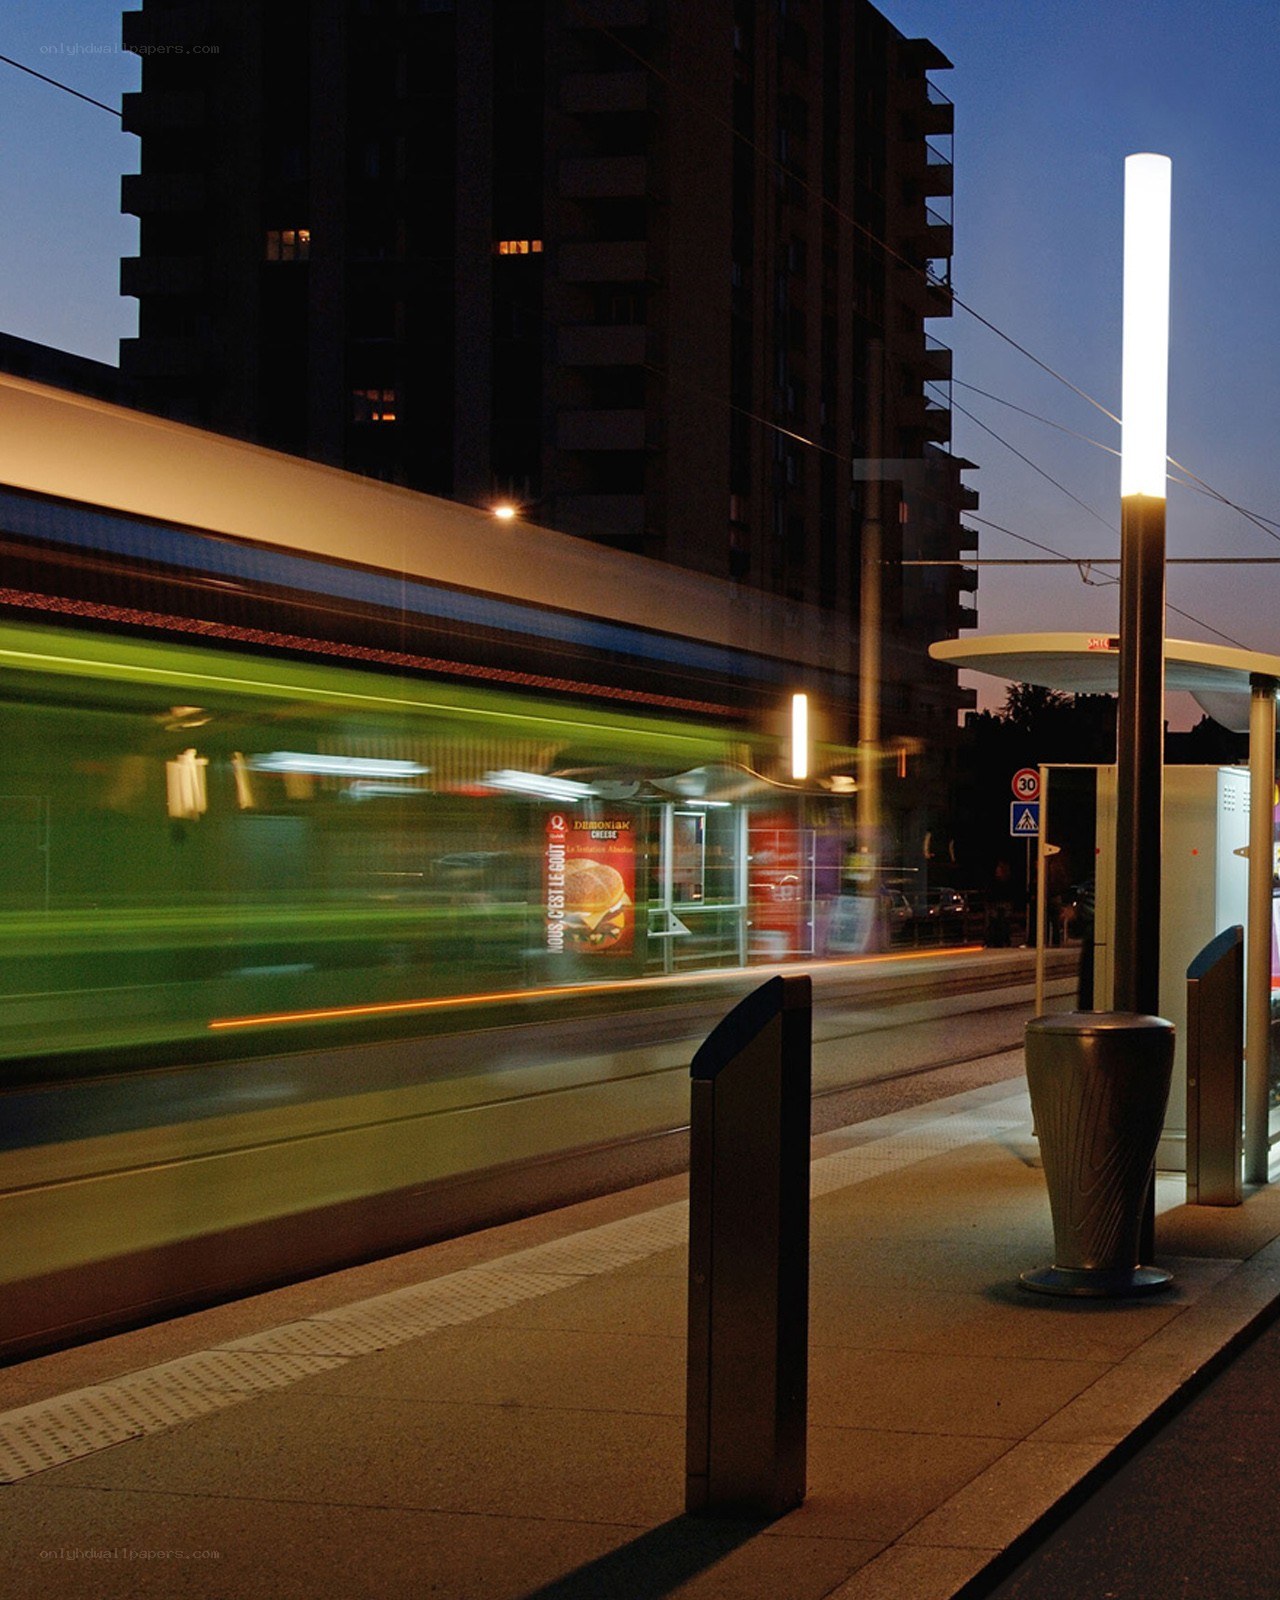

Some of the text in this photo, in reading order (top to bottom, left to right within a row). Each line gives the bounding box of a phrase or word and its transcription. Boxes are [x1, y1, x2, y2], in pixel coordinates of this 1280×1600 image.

[1019, 778, 1035, 791] 30
[551, 815, 565, 830] Q
[591, 831, 618, 839] CHEESE
[545, 843, 566, 954] NOUS, C'EST LE GOÛT
